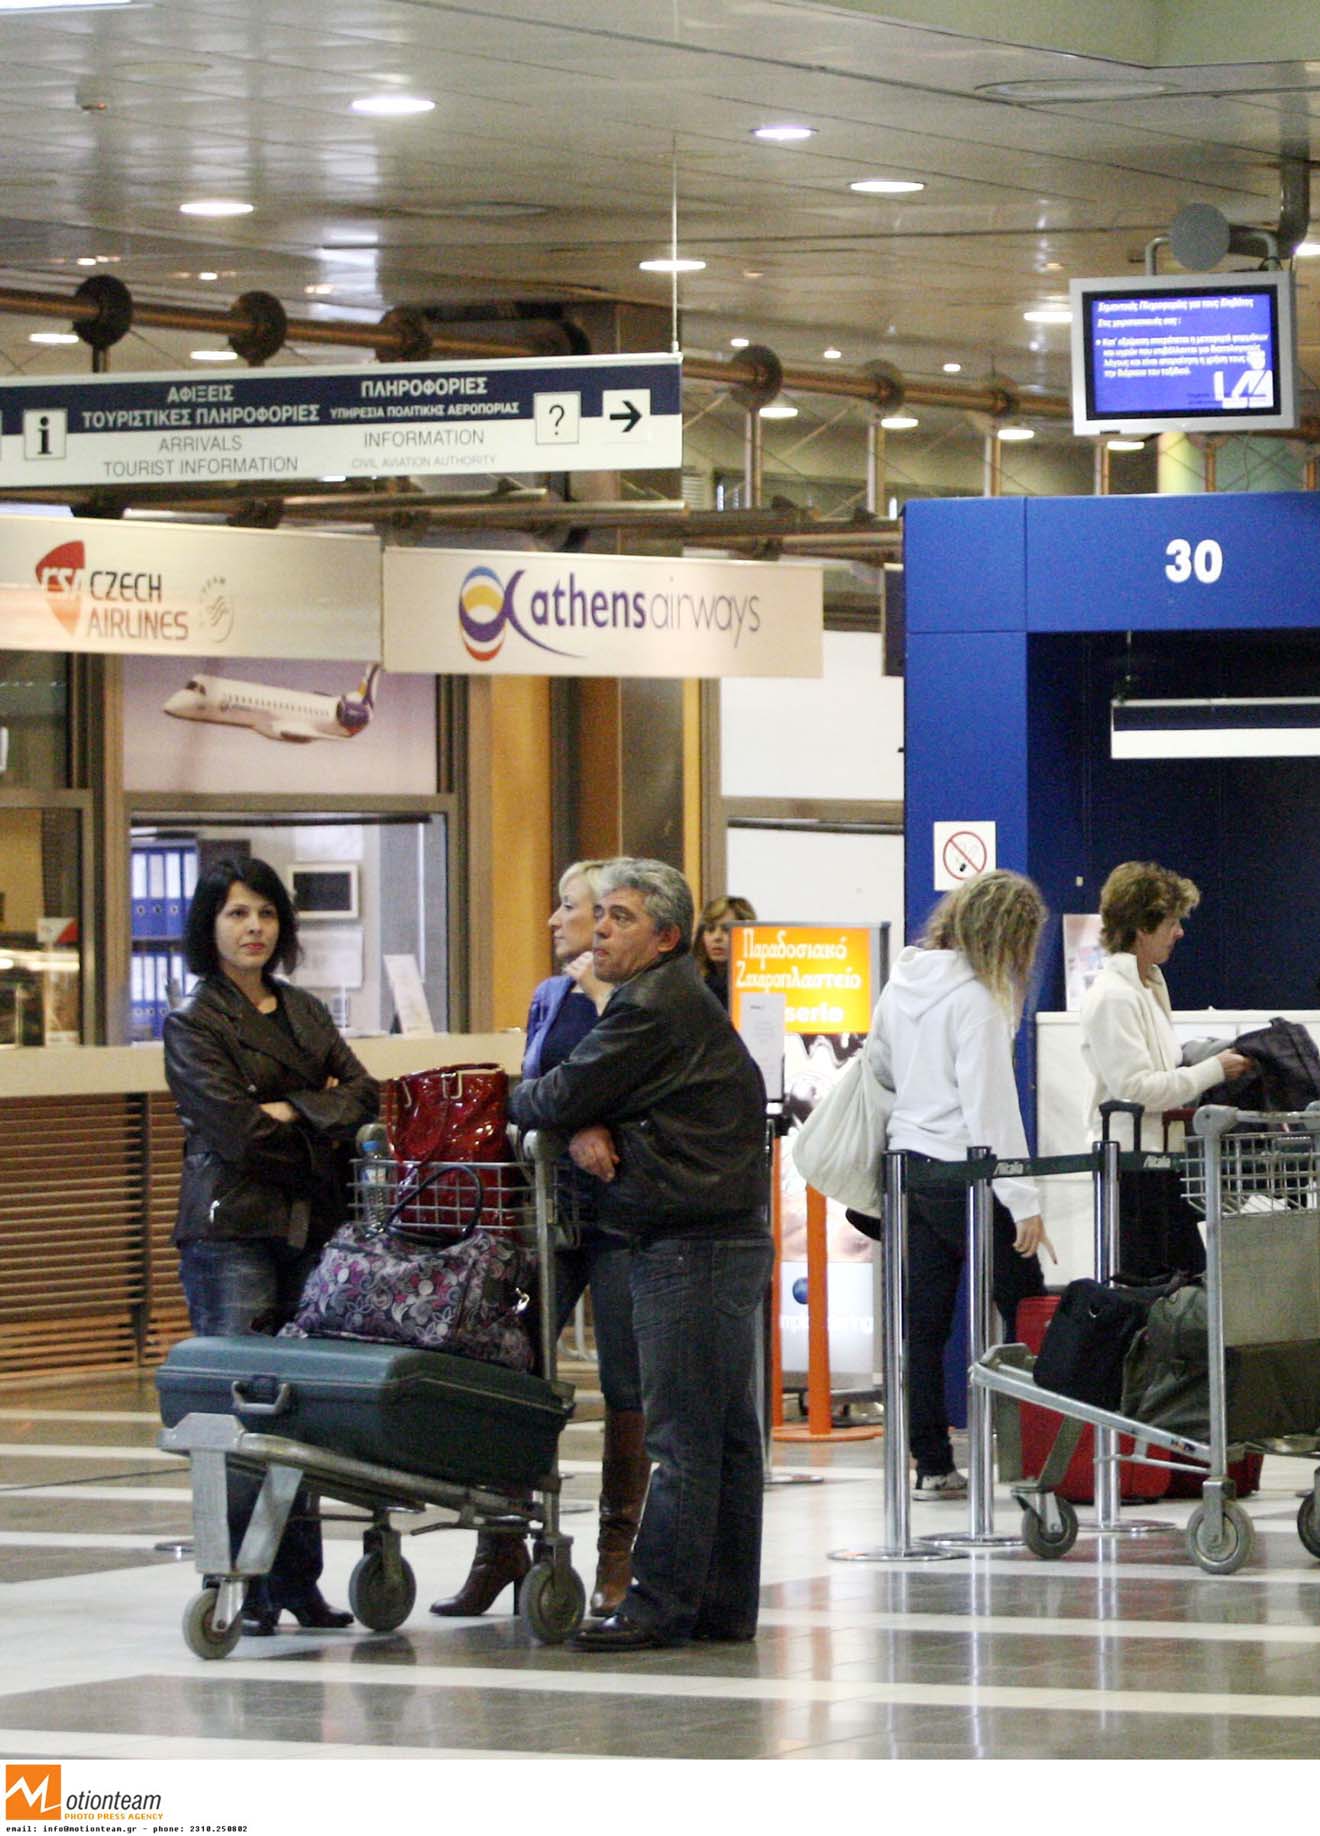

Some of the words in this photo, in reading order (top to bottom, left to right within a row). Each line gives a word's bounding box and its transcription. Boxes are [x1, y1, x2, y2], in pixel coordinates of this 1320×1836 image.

[167, 384, 235, 403] ΑΦΙΞΕΙΣ
[361, 377, 488, 398] ΠΛΗΡΟΦΟΡΙΕΣ
[82, 408, 193, 429] ΤΟΥΡΙΣΤΙΚΕΣ
[196, 404, 320, 425] ΠΛΗΡΟΦΟΡΙΕΣ
[330, 406, 384, 419] ΥΠΗΡΕΣΙΑ
[387, 404, 445, 418] ΠΟΛΙΤΙΚΗΣ
[447, 402, 519, 416] ΑΕΡΟΠΟΡΙΑΣ
[159, 434, 243, 453] ARRIVALS
[364, 429, 485, 448] INFORMATION
[103, 459, 175, 478] TOURIST
[180, 456, 298, 475] INFORMATION
[351, 457, 380, 470] CIVIL
[382, 456, 431, 468] AVIATION
[433, 454, 496, 467] AUTHORITY
[1165, 538, 1223, 584] 30
[90, 570, 162, 603] CZECH
[88, 607, 189, 641] AIRLINES
[742, 927, 849, 970] Παραδοσιακό
